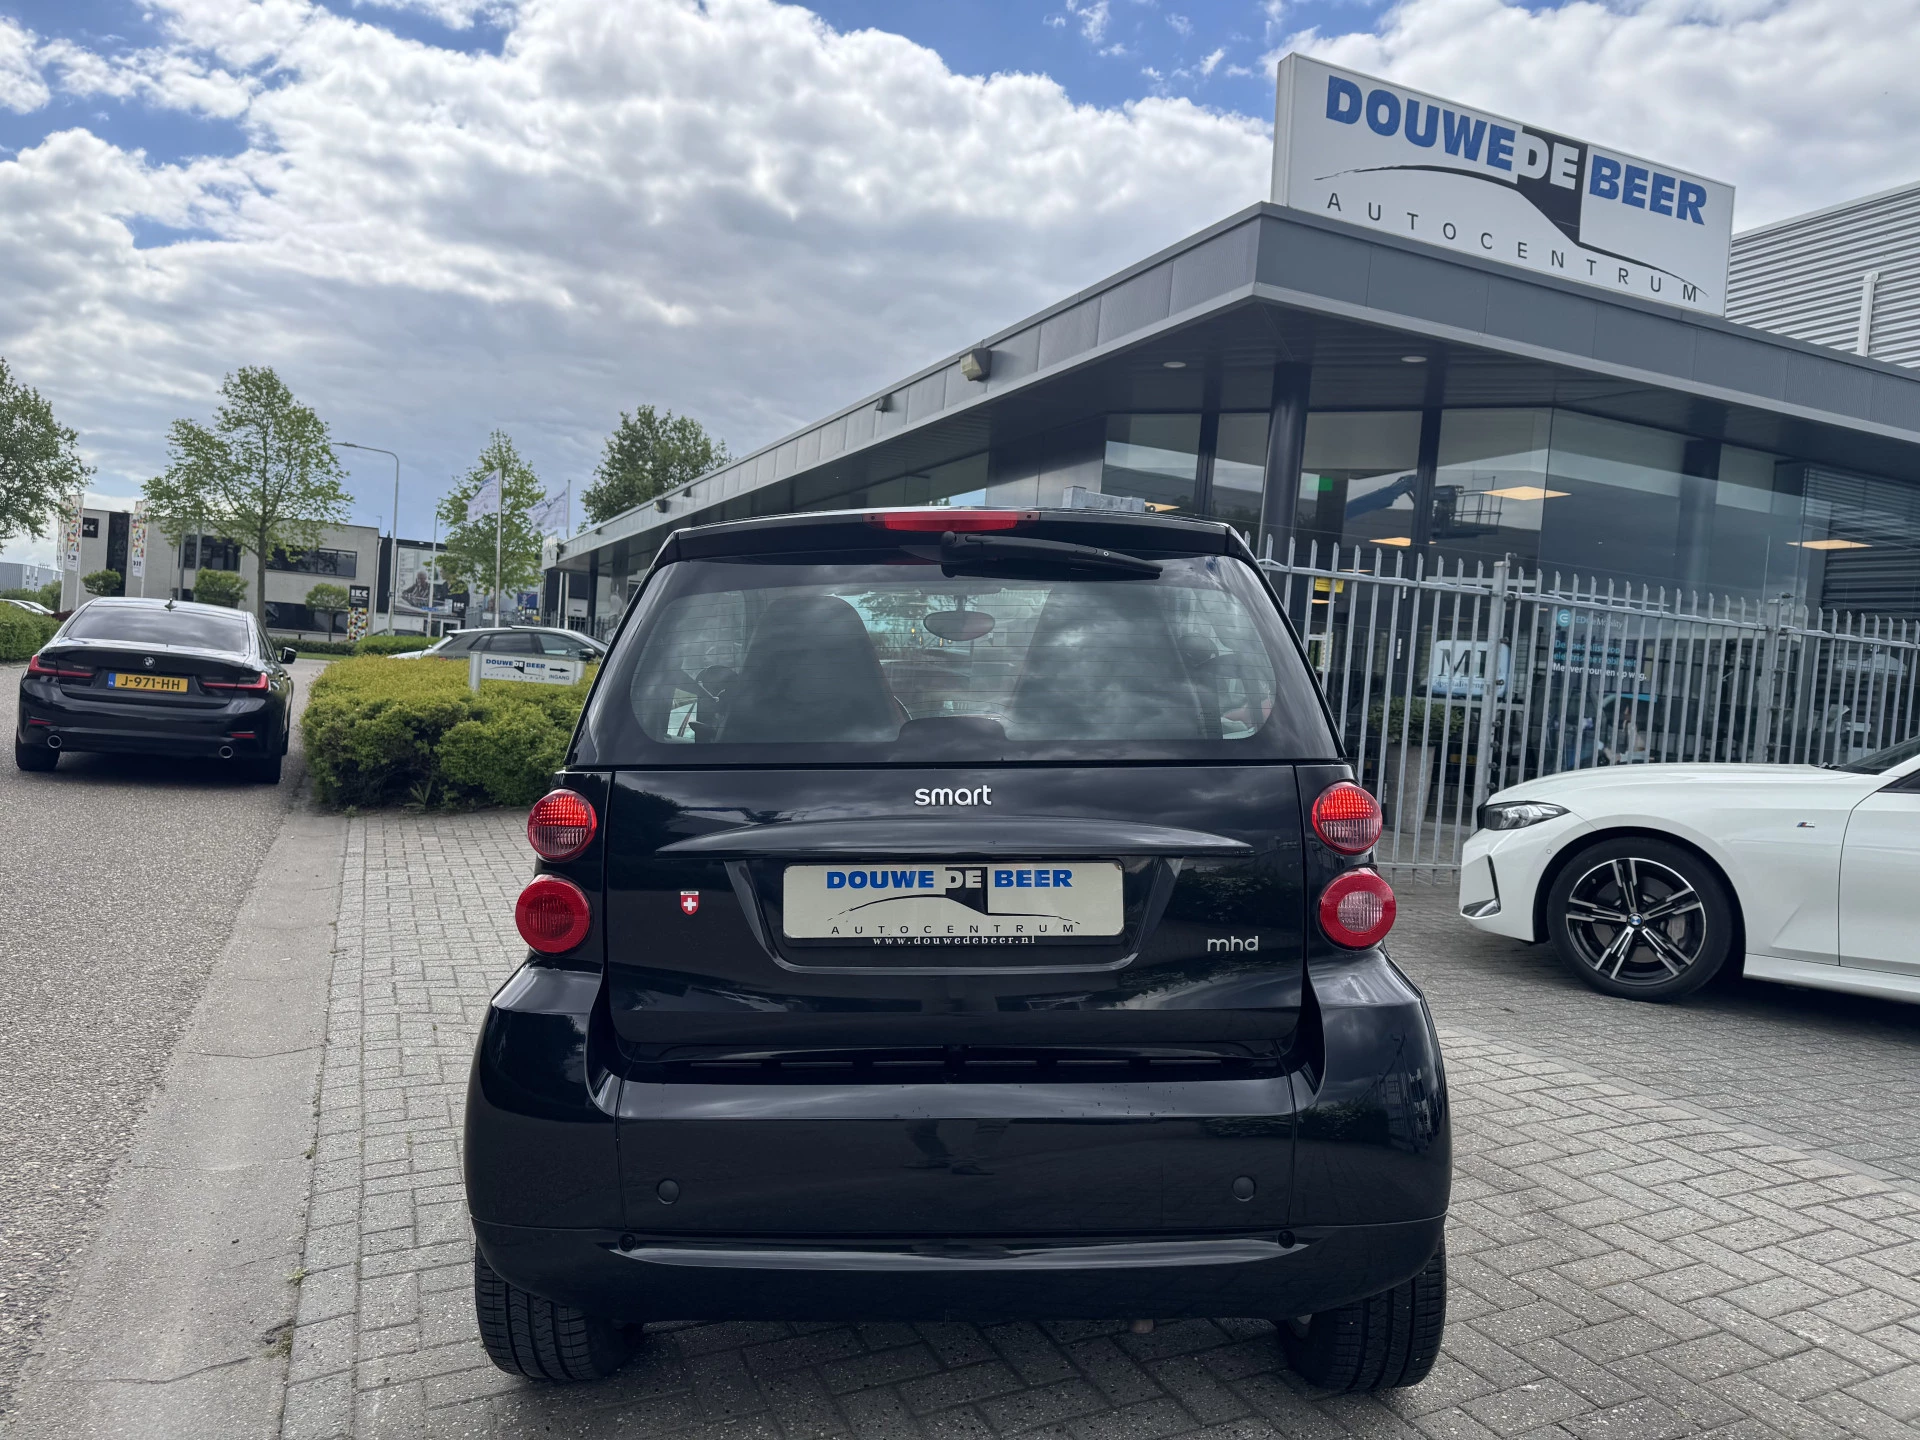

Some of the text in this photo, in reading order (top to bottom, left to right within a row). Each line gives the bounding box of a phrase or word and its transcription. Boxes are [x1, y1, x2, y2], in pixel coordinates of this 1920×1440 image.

[1325, 74, 1708, 226] DOUWE DE BEER
[1326, 192, 1698, 303] AUTOCENTRUM
[485, 658, 513, 667] DOUWE
[121, 675, 181, 691] J-971-HH
[914, 784, 992, 806] smart
[826, 869, 1073, 889] DOUWE DE BEER
[831, 924, 1075, 935] AUTOCENTRUM
[872, 935, 1036, 946] www.douwedebeer.nl
[1207, 935, 1259, 952] mhd
